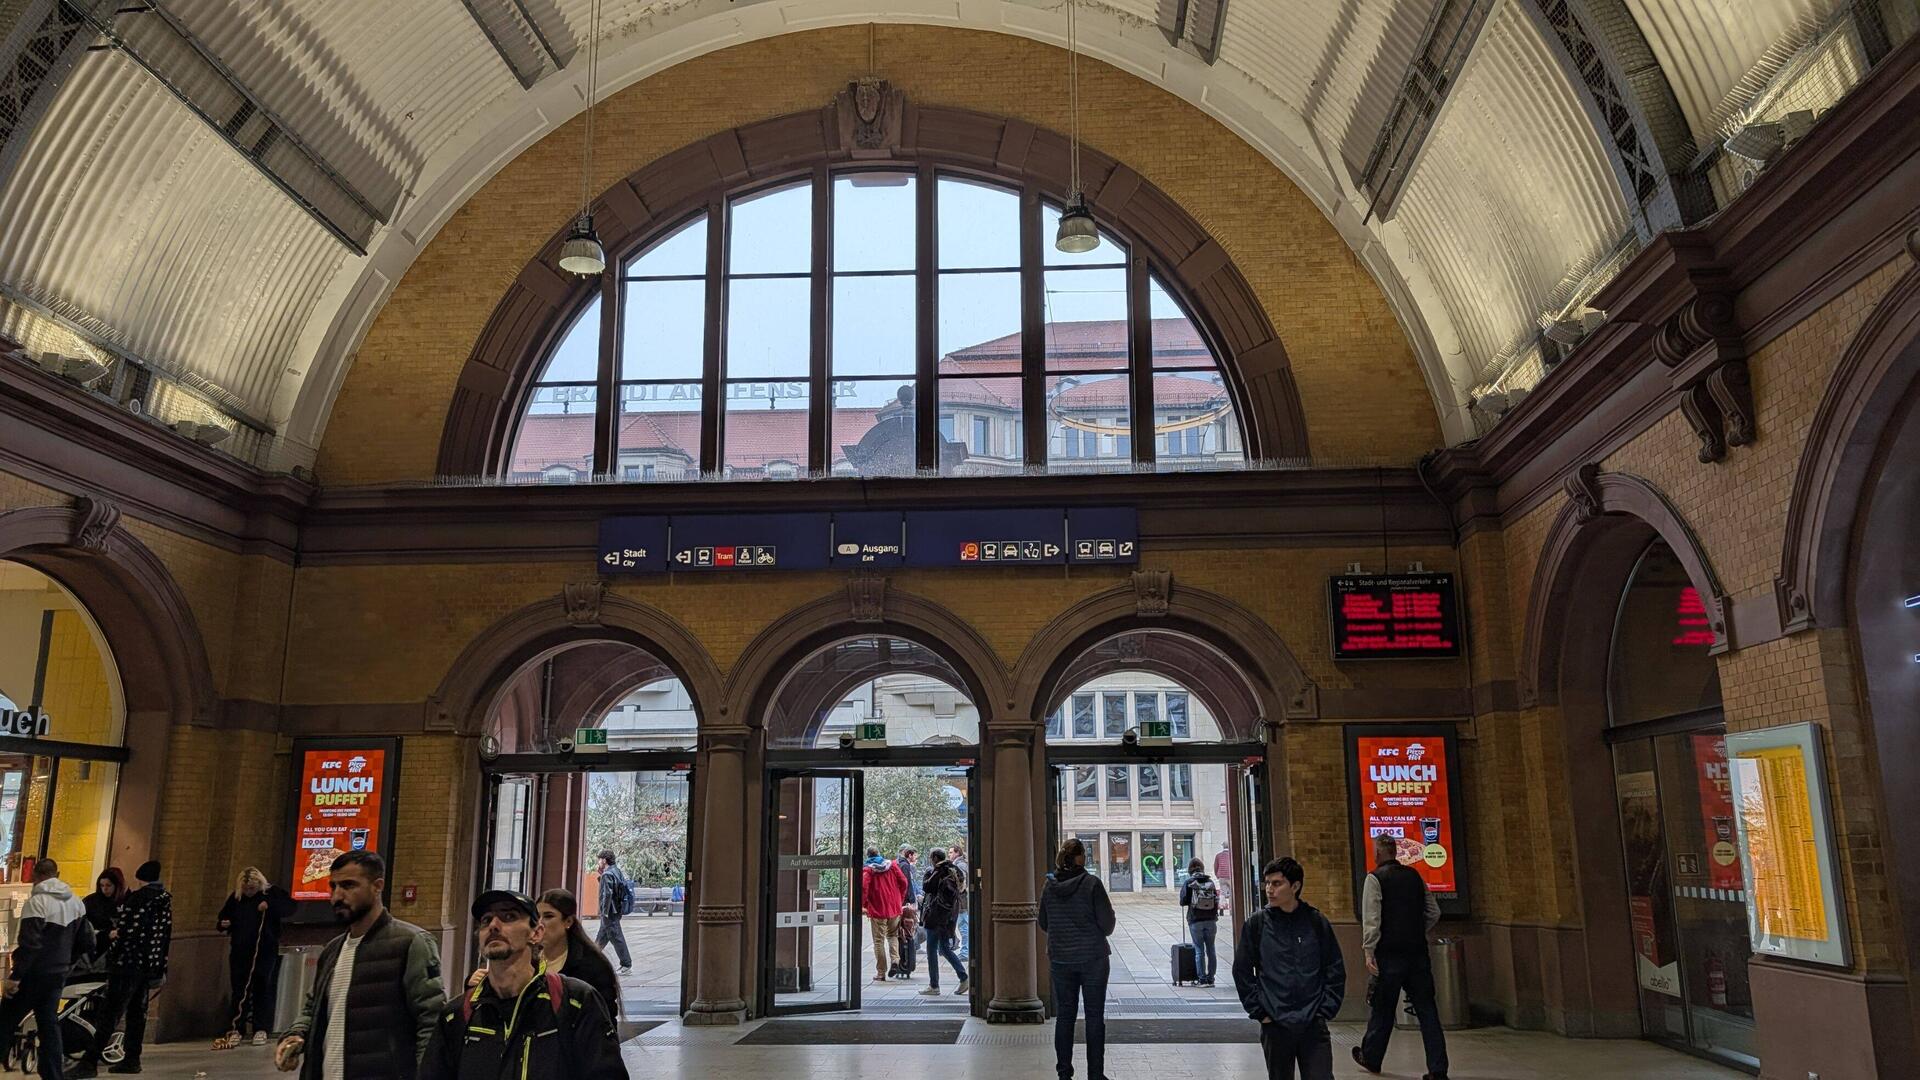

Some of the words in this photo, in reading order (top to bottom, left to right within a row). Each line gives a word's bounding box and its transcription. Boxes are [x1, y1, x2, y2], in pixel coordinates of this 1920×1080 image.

[623, 548, 647, 558] Stadt
[862, 544, 899, 554] Ausgang
[716, 552, 734, 561] Tram
[622, 560, 636, 568] City
[322, 761, 342, 769] KFC
[1370, 764, 1437, 781] LUNCH
[311, 776, 374, 794] LUNCH
[1376, 782, 1432, 794] BUFFET
[315, 794, 368, 806] BUFFET
